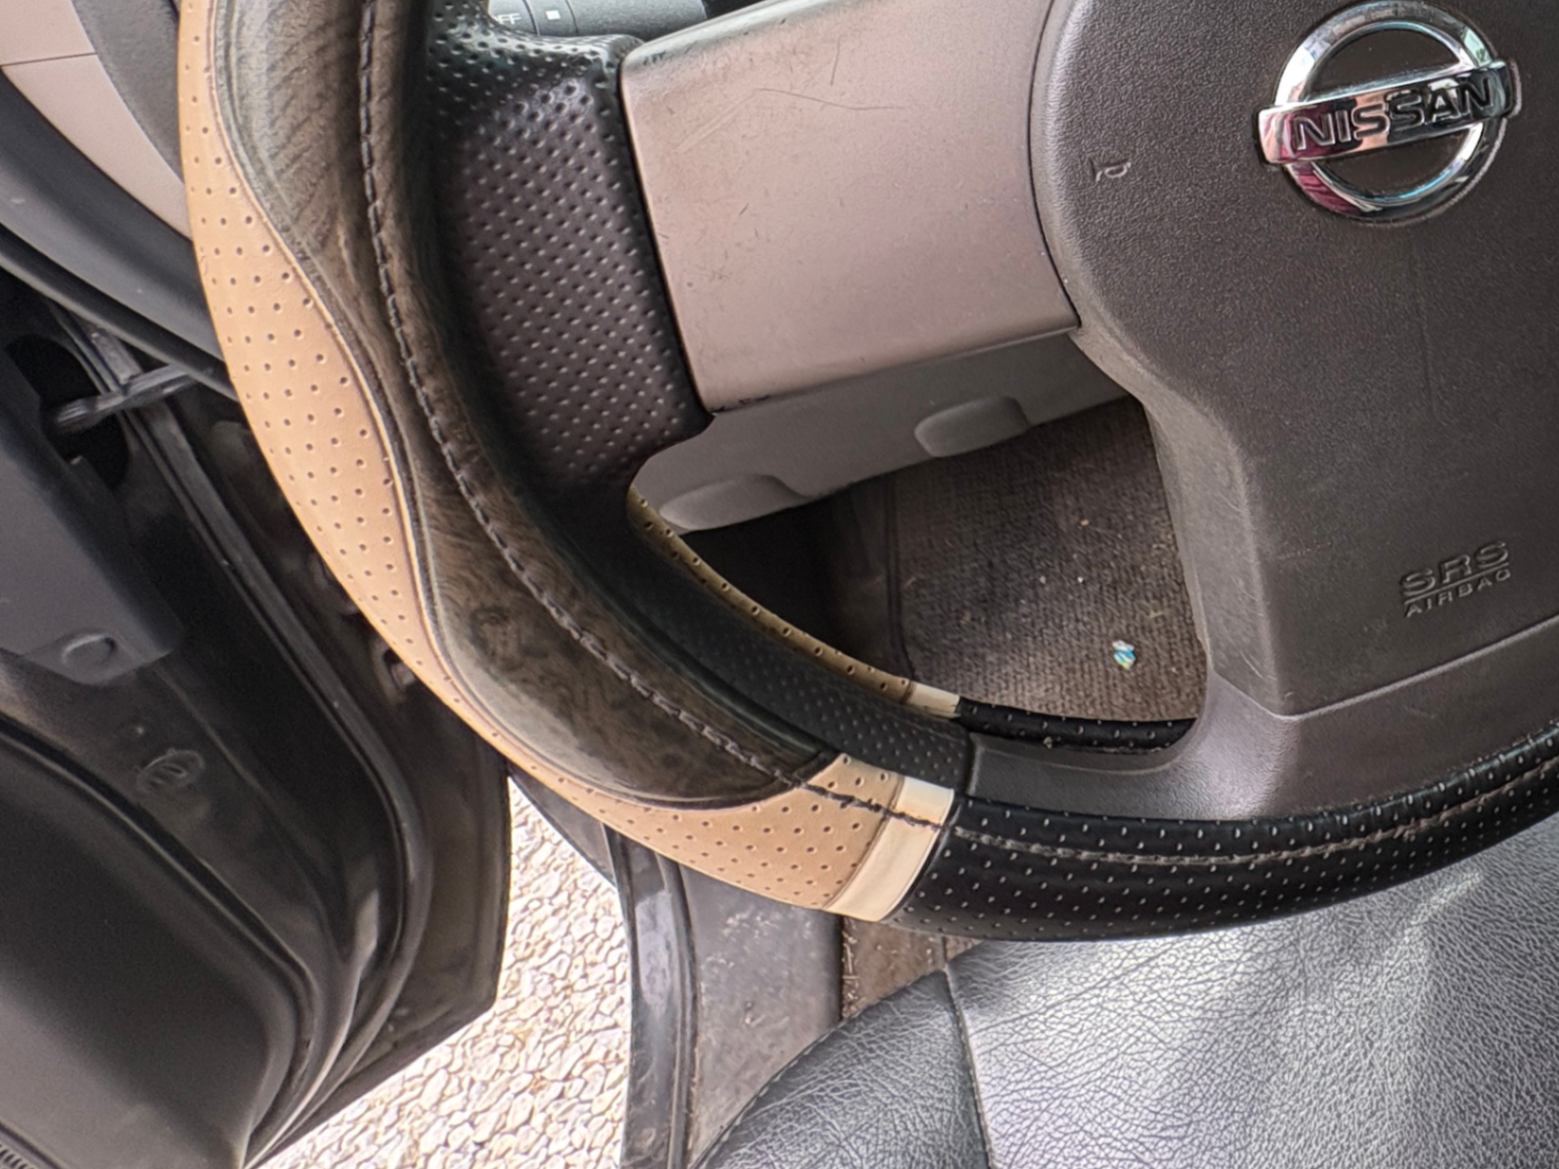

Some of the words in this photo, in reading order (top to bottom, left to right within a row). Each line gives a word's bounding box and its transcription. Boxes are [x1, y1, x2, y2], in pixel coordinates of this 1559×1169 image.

[496, 12, 522, 25] FF
[1290, 75, 1496, 151] NISSAN
[1401, 541, 1509, 596] SRS
[1405, 568, 1512, 618] AIRBAG
